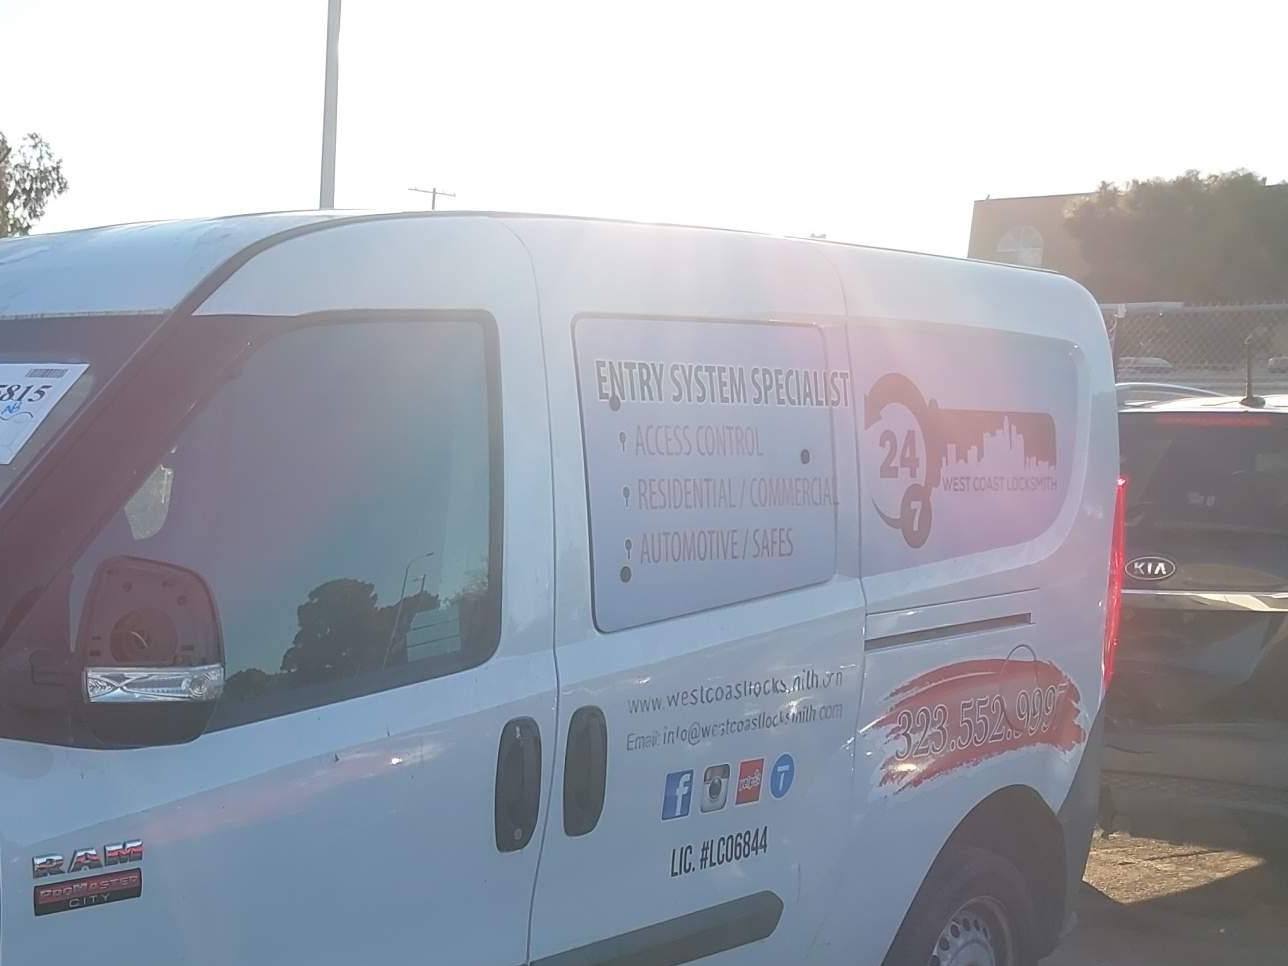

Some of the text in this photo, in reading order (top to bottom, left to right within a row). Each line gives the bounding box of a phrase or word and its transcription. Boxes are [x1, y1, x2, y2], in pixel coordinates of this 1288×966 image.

[595, 360, 850, 408] ENTRY SYSTEM SPECIALIST
[635, 425, 764, 457] ACCESS CONTROL
[879, 429, 920, 479] 24
[638, 478, 736, 510] RESIDENTIAL
[750, 476, 840, 508] COMMERCIAL
[942, 476, 1058, 492] WEST COAST LOCKSMITH
[911, 501, 922, 532] 7
[640, 529, 738, 564] AUTOMOTIVE
[752, 527, 794, 558] SAFES
[1134, 562, 1167, 575] KIA
[32, 839, 143, 878] RAM
[670, 845, 696, 877] LIC.
[69, 892, 110, 908] CITY
